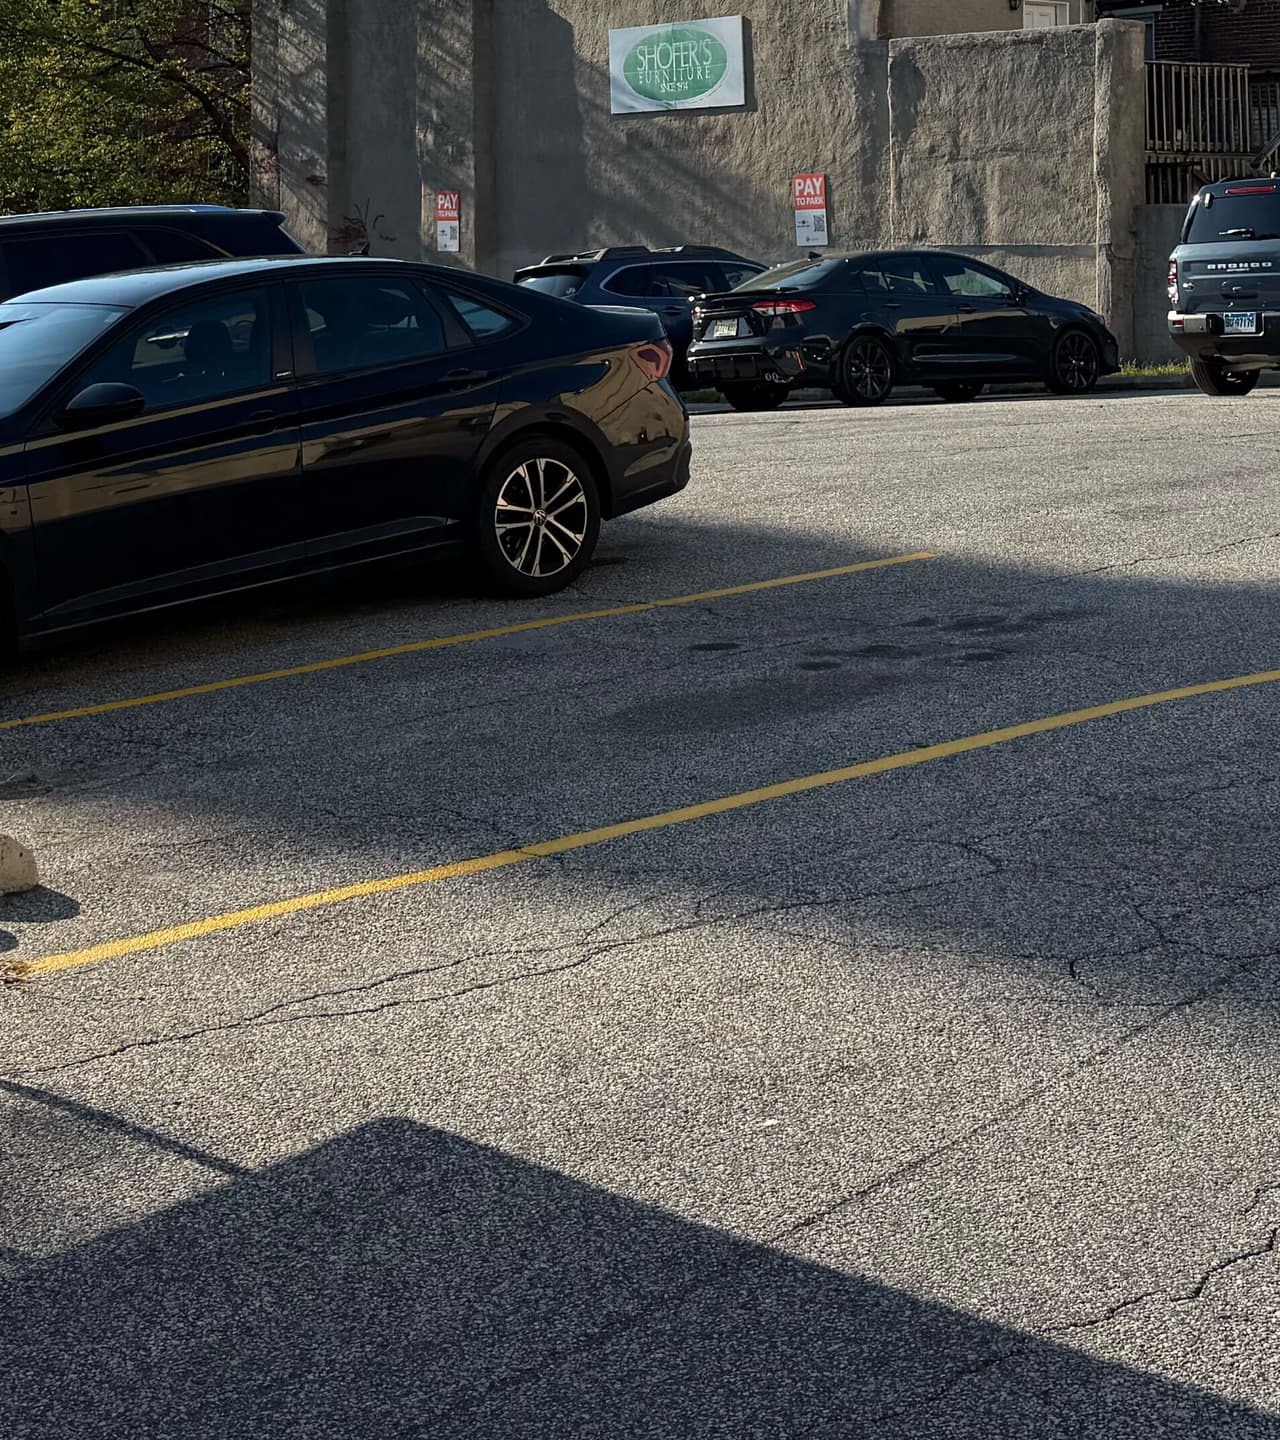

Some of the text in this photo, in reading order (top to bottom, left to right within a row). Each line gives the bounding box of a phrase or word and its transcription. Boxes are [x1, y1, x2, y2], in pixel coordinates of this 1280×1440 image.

[637, 39, 712, 72] SHOFER'S
[639, 66, 711, 84] FURNITURE
[795, 177, 822, 196] PAY
[438, 194, 458, 209] PAY
[796, 196, 824, 206] TO PARK
[1207, 262, 1272, 270] BRONCO
